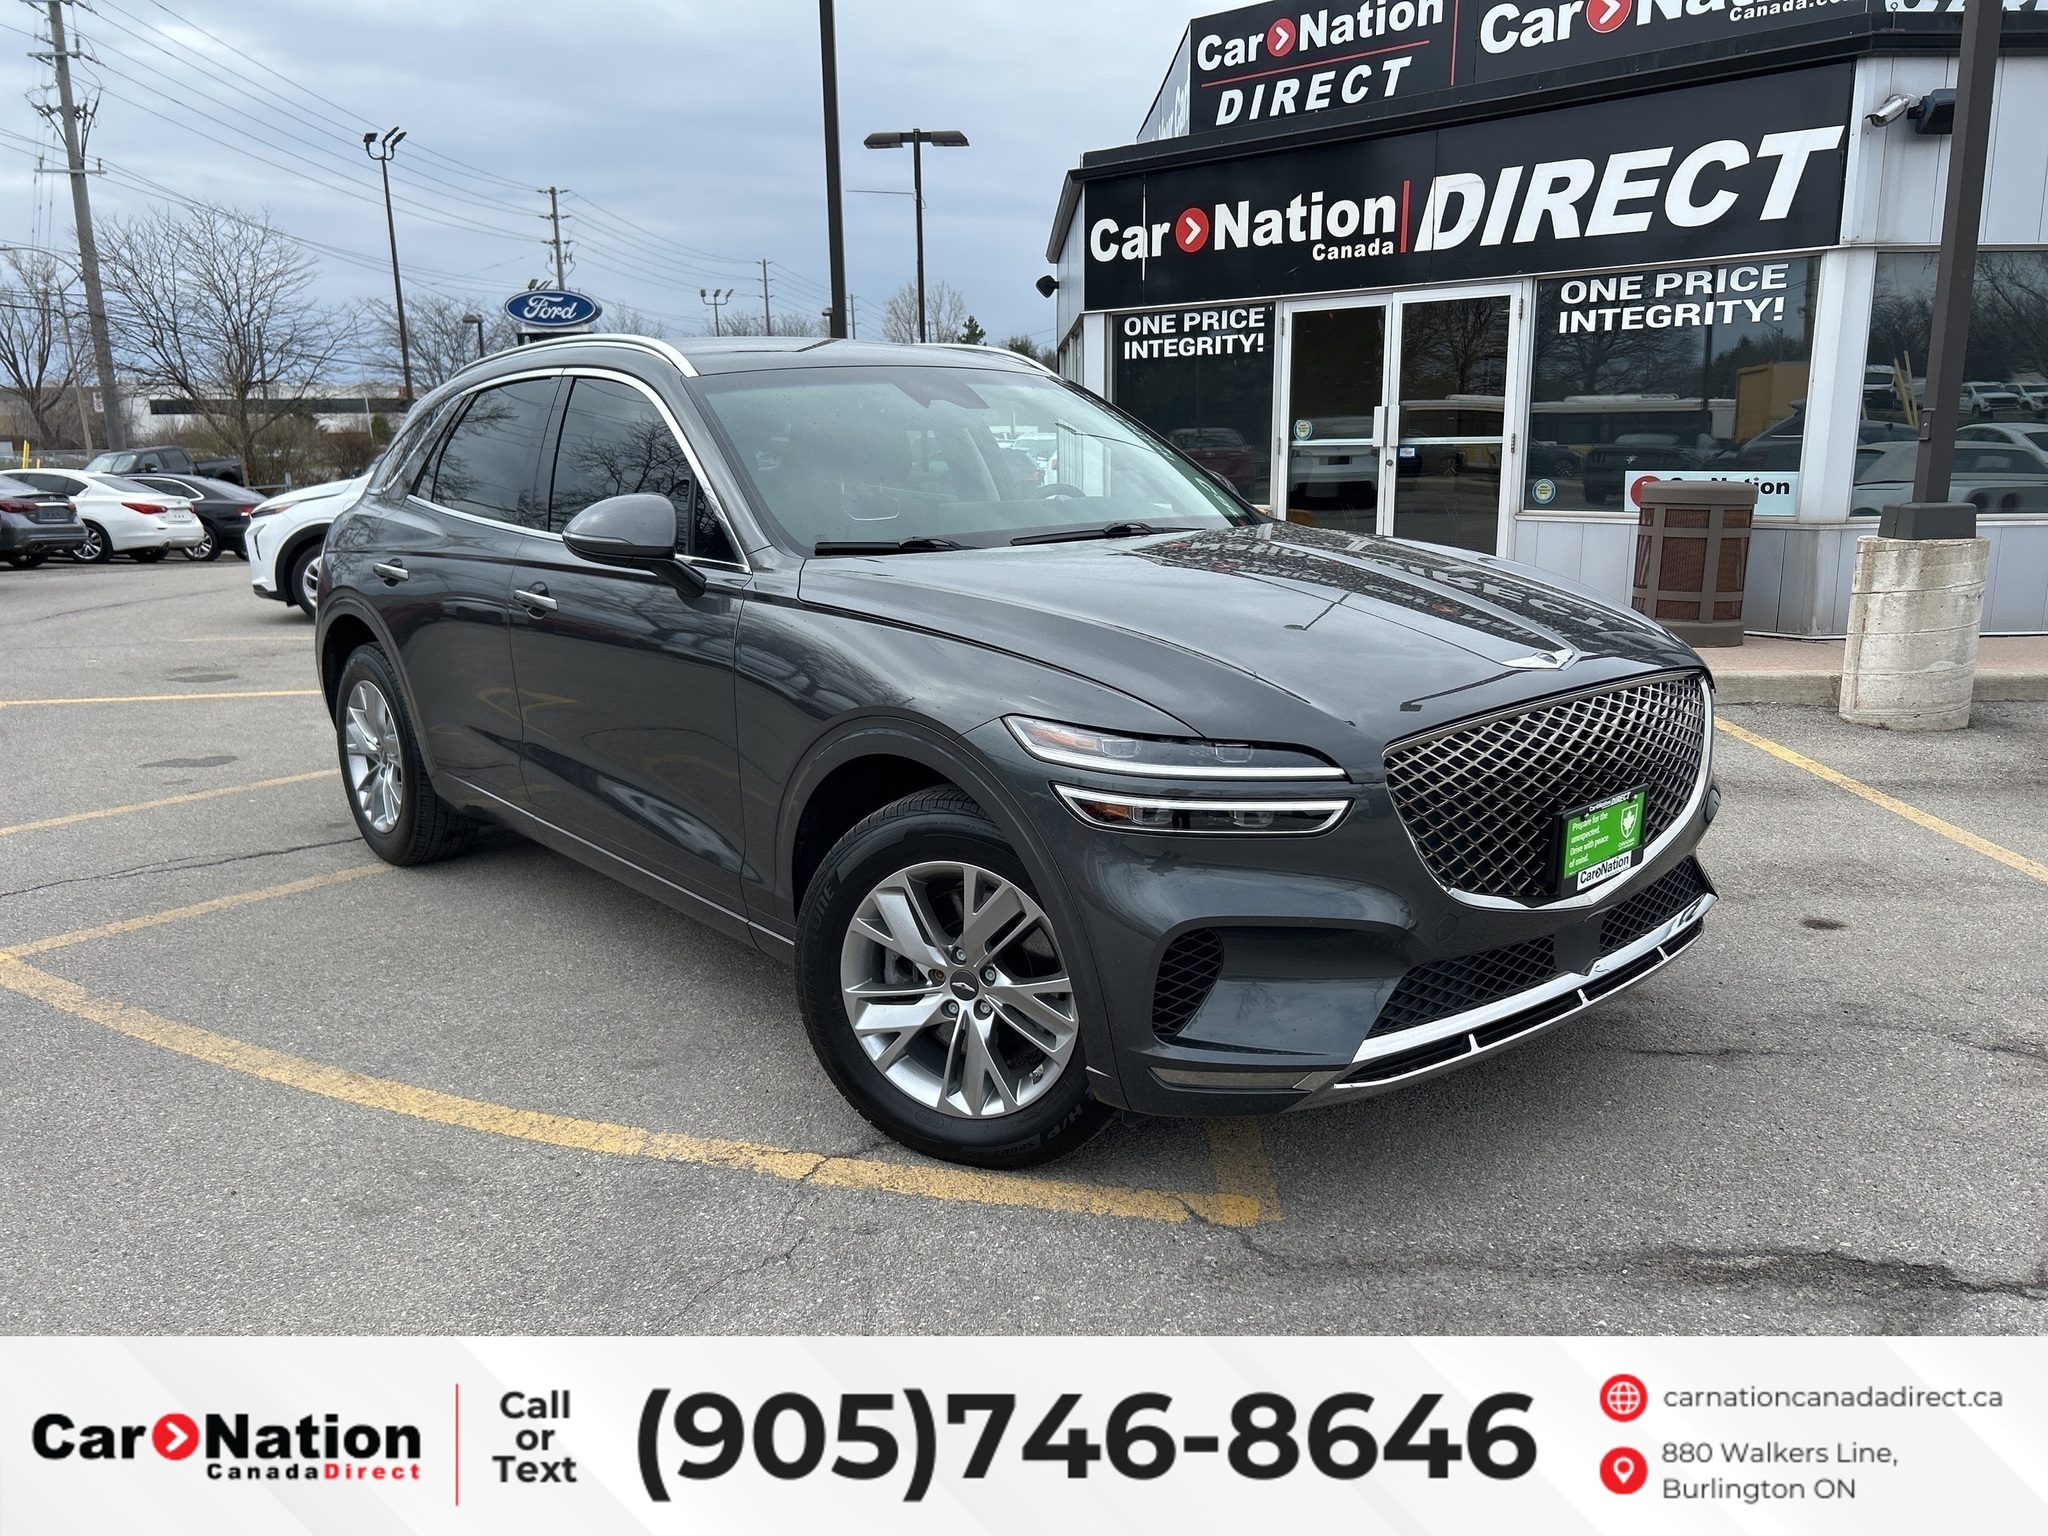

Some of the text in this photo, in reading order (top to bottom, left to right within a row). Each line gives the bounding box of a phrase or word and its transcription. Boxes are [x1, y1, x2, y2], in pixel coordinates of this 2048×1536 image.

[1197, 0, 1444, 71] Car Nation
[1480, 0, 1584, 54] Car
[1215, 56, 1413, 126] DIRECT
[1090, 125, 1846, 262] Car Nation DIRECT
[1311, 238, 1395, 261] Canada
[1559, 263, 1789, 304] ONE PRICE
[523, 295, 578, 319] Ford
[1124, 308, 1266, 337] ONE PRICE
[1557, 297, 1785, 334] INTEGRITY!
[1124, 333, 1265, 360] INTEGRITY!
